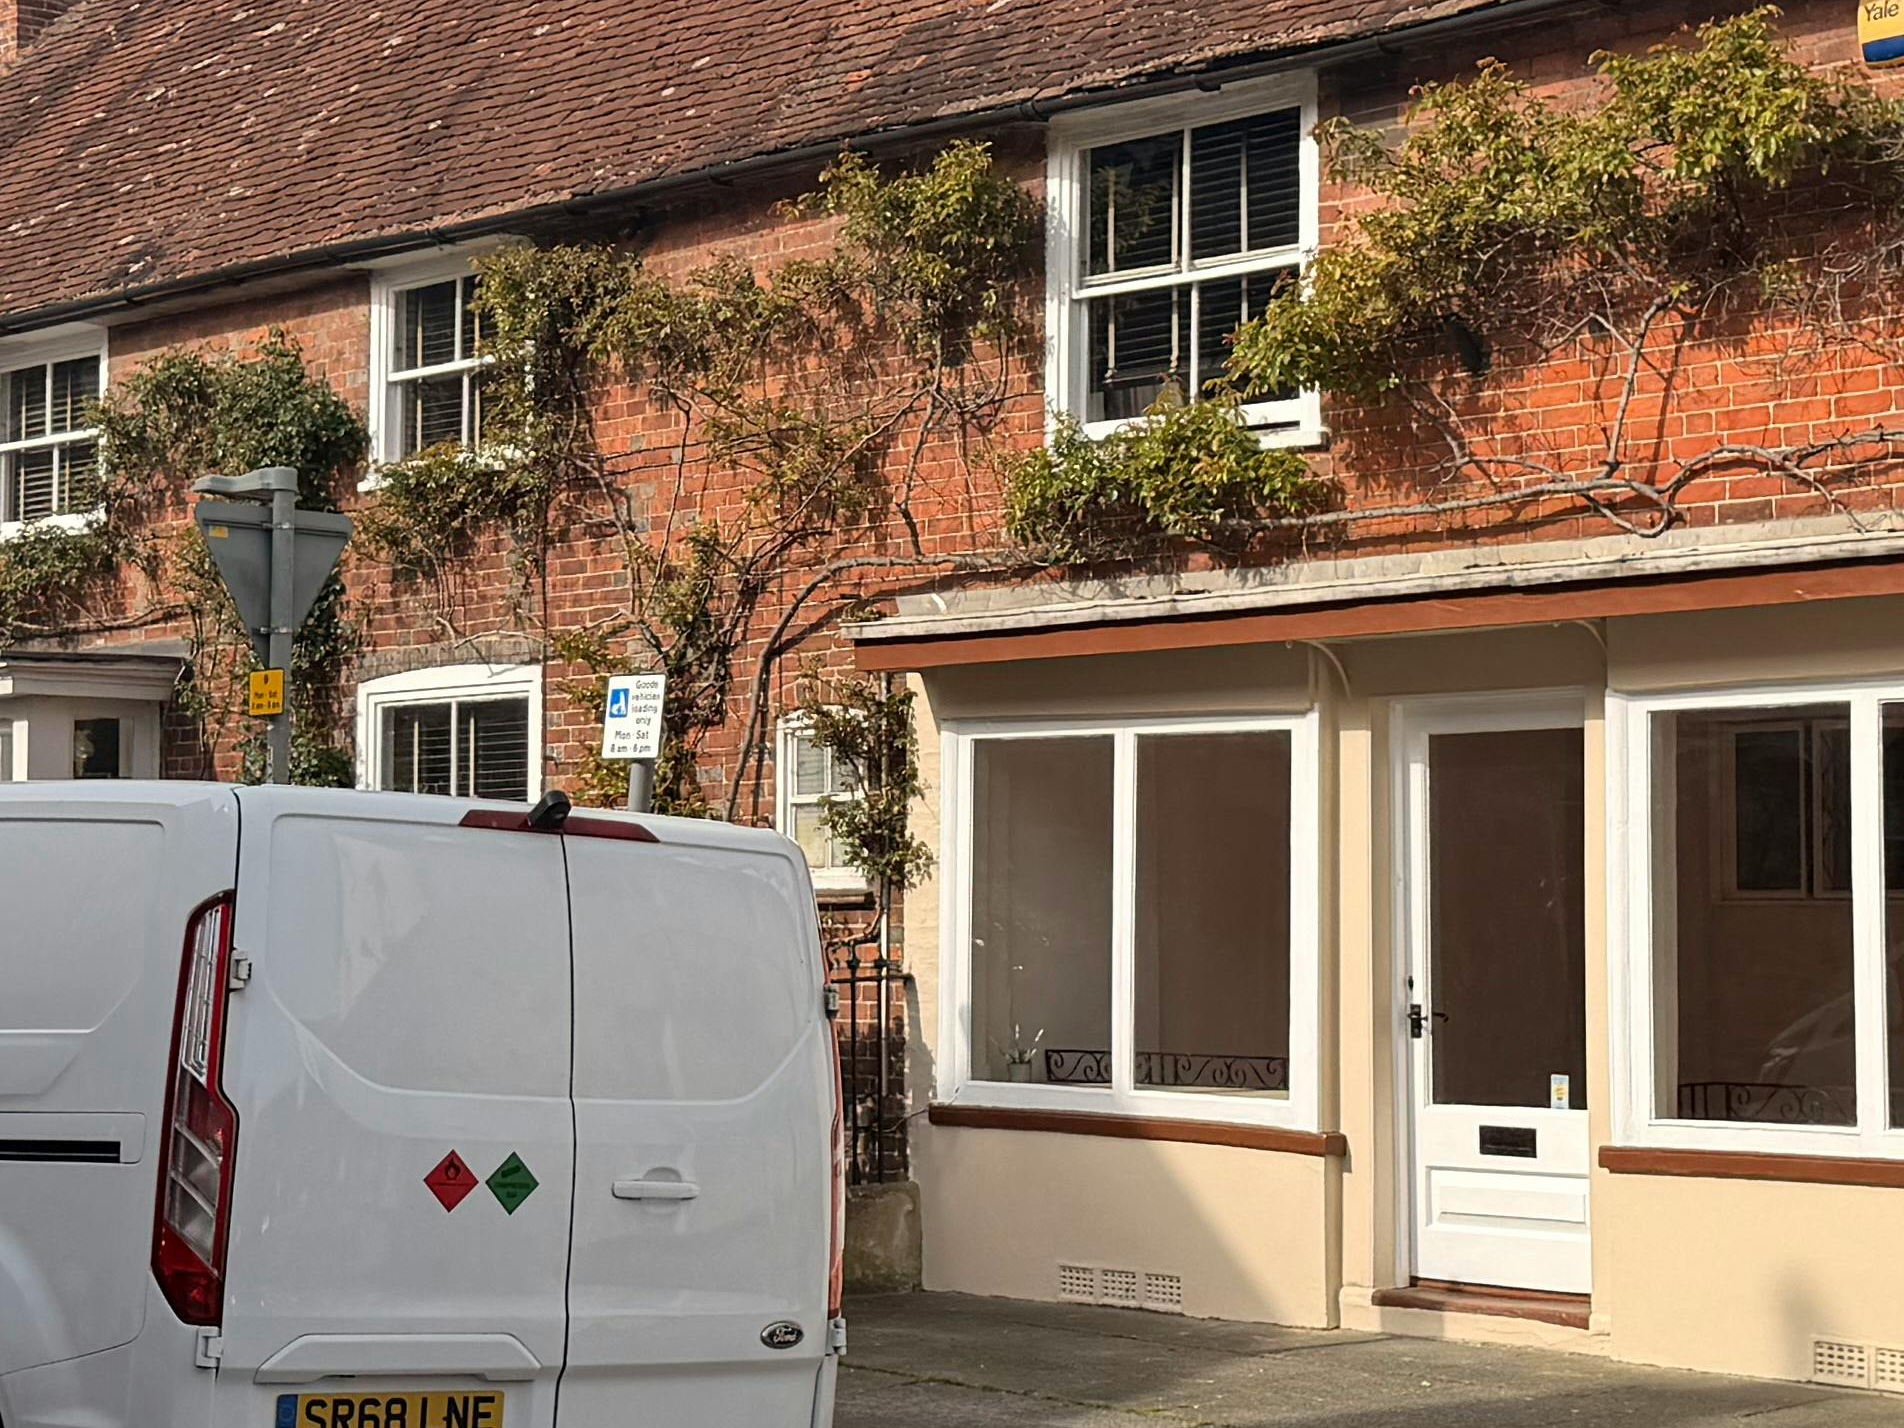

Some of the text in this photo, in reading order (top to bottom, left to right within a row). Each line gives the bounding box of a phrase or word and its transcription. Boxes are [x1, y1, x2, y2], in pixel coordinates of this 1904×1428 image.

[1864, 0, 1899, 22] Yale
[636, 680, 658, 689] Goods
[632, 693, 660, 701] vehicles
[631, 704, 658, 714] loading
[636, 716, 651, 726] only
[615, 730, 649, 740] Mon Sat
[639, 745, 651, 753] pm
